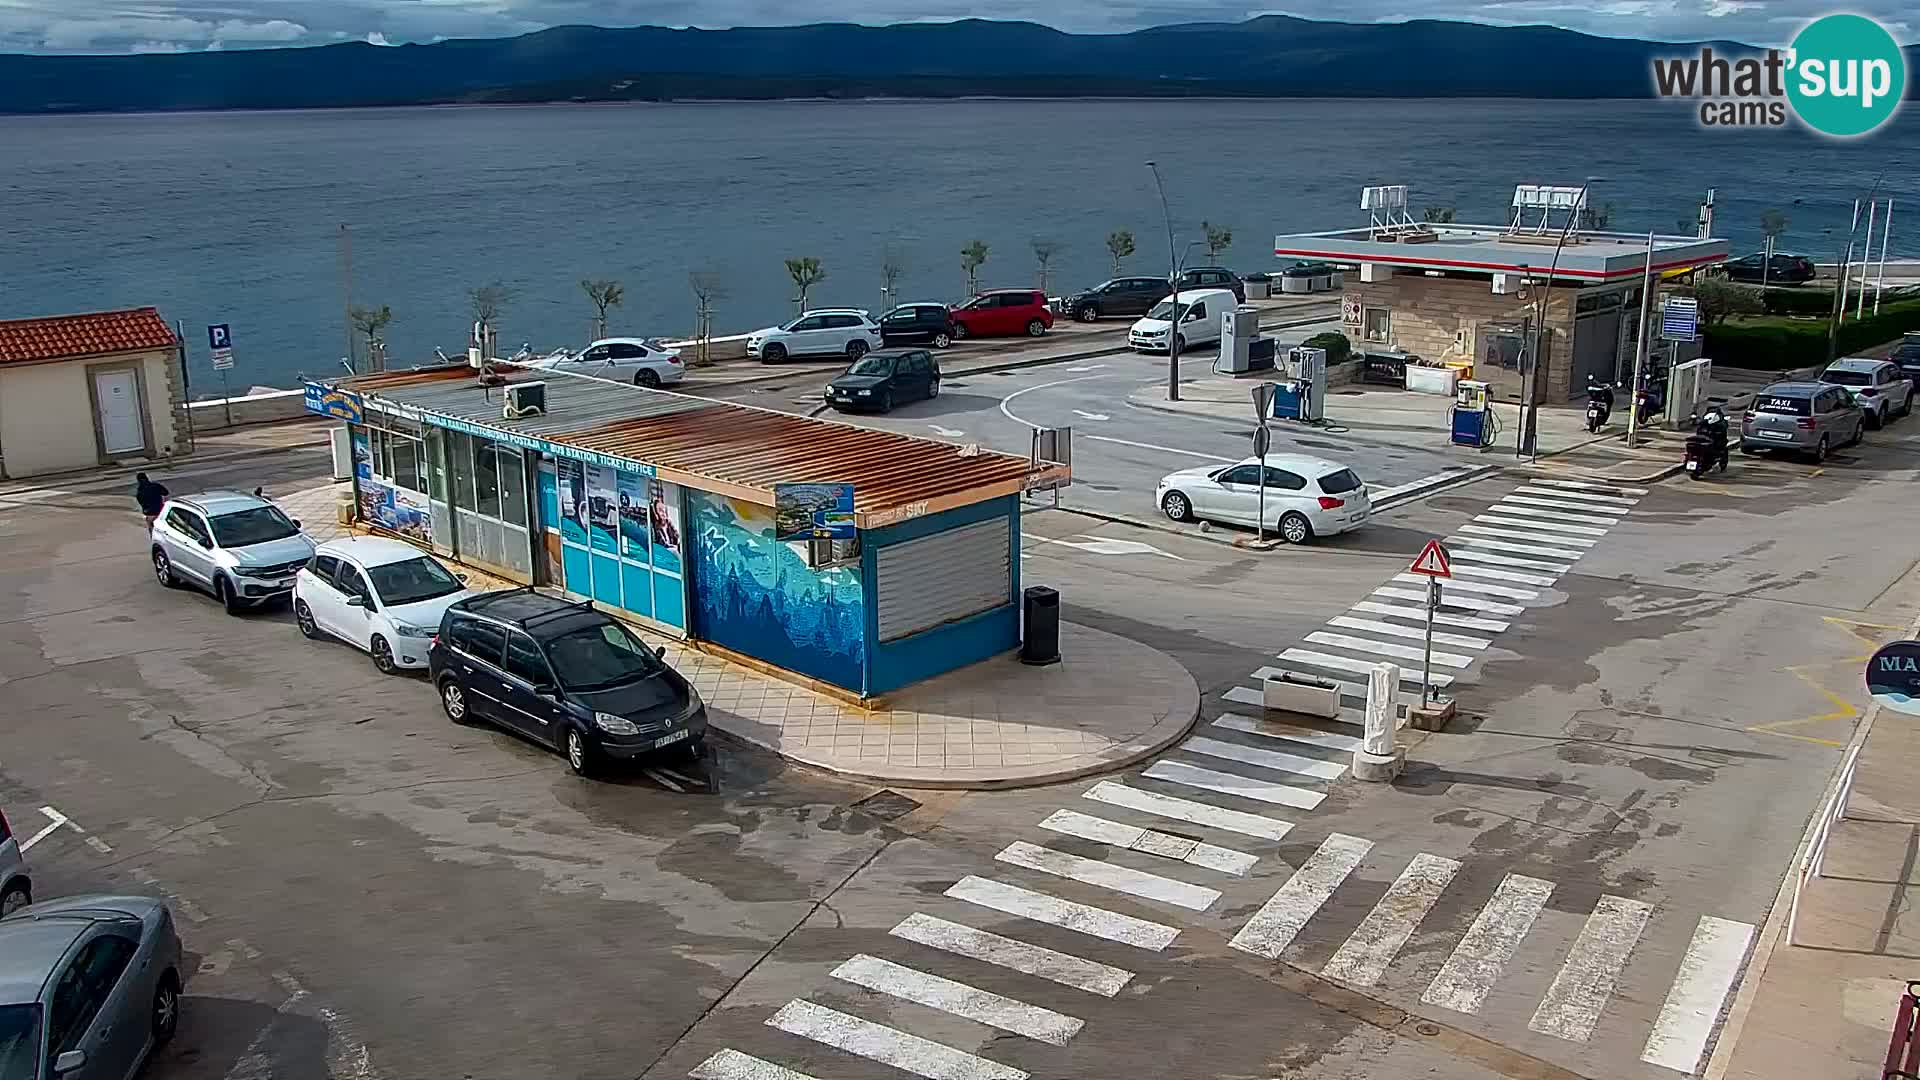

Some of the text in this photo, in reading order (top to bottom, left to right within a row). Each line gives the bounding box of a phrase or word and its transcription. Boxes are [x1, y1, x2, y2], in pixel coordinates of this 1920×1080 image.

[213, 327, 225, 346] P
[1770, 398, 1791, 407] TAXI
[509, 435, 540, 449] POSTAJA
[550, 444, 565, 456] BUS
[565, 448, 598, 463] STATION
[599, 455, 624, 469] TICKET
[626, 462, 653, 475] OFFICE
